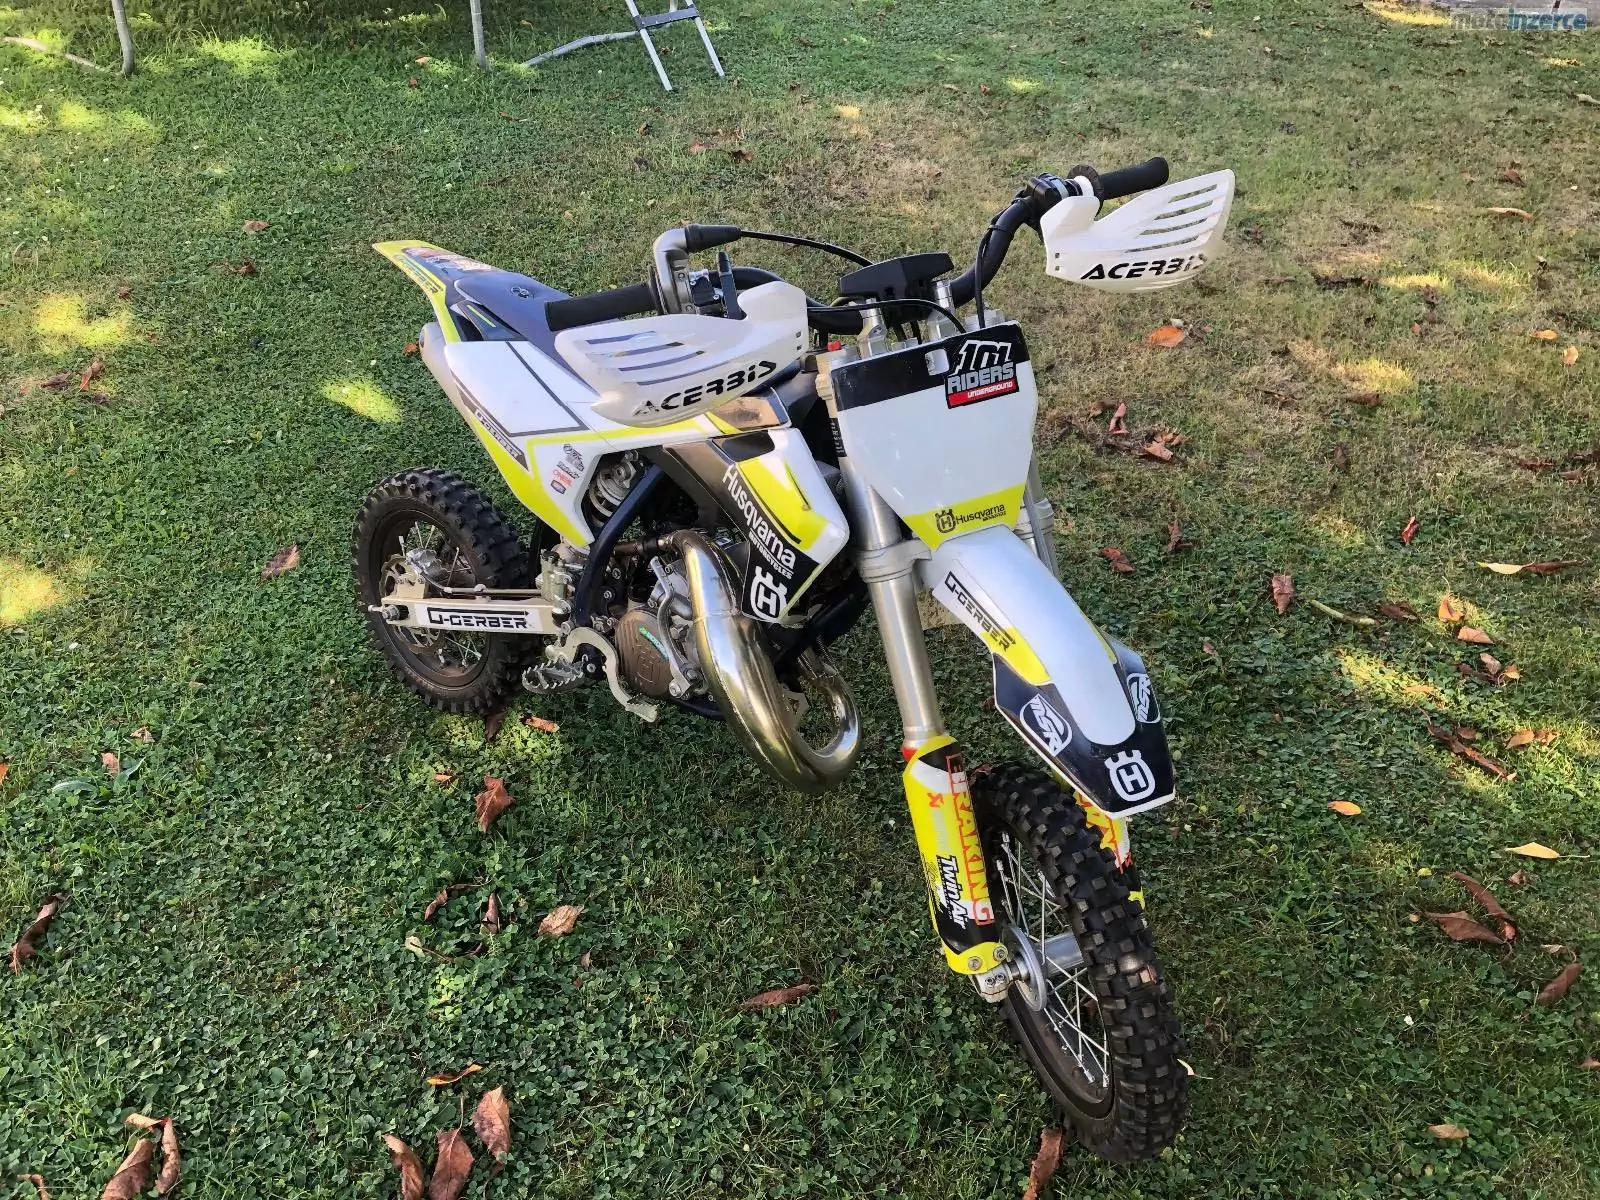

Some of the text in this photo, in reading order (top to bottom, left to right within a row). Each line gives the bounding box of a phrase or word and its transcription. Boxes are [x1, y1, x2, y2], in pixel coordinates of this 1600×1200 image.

[1080, 252, 1208, 280] ACERBIS
[632, 360, 777, 416] ACERBIS
[948, 361, 1014, 395] RIDERS
[722, 463, 797, 570] Husqvarna
[955, 504, 1005, 525] Husqvarna
[946, 754, 995, 926] BRAKING
